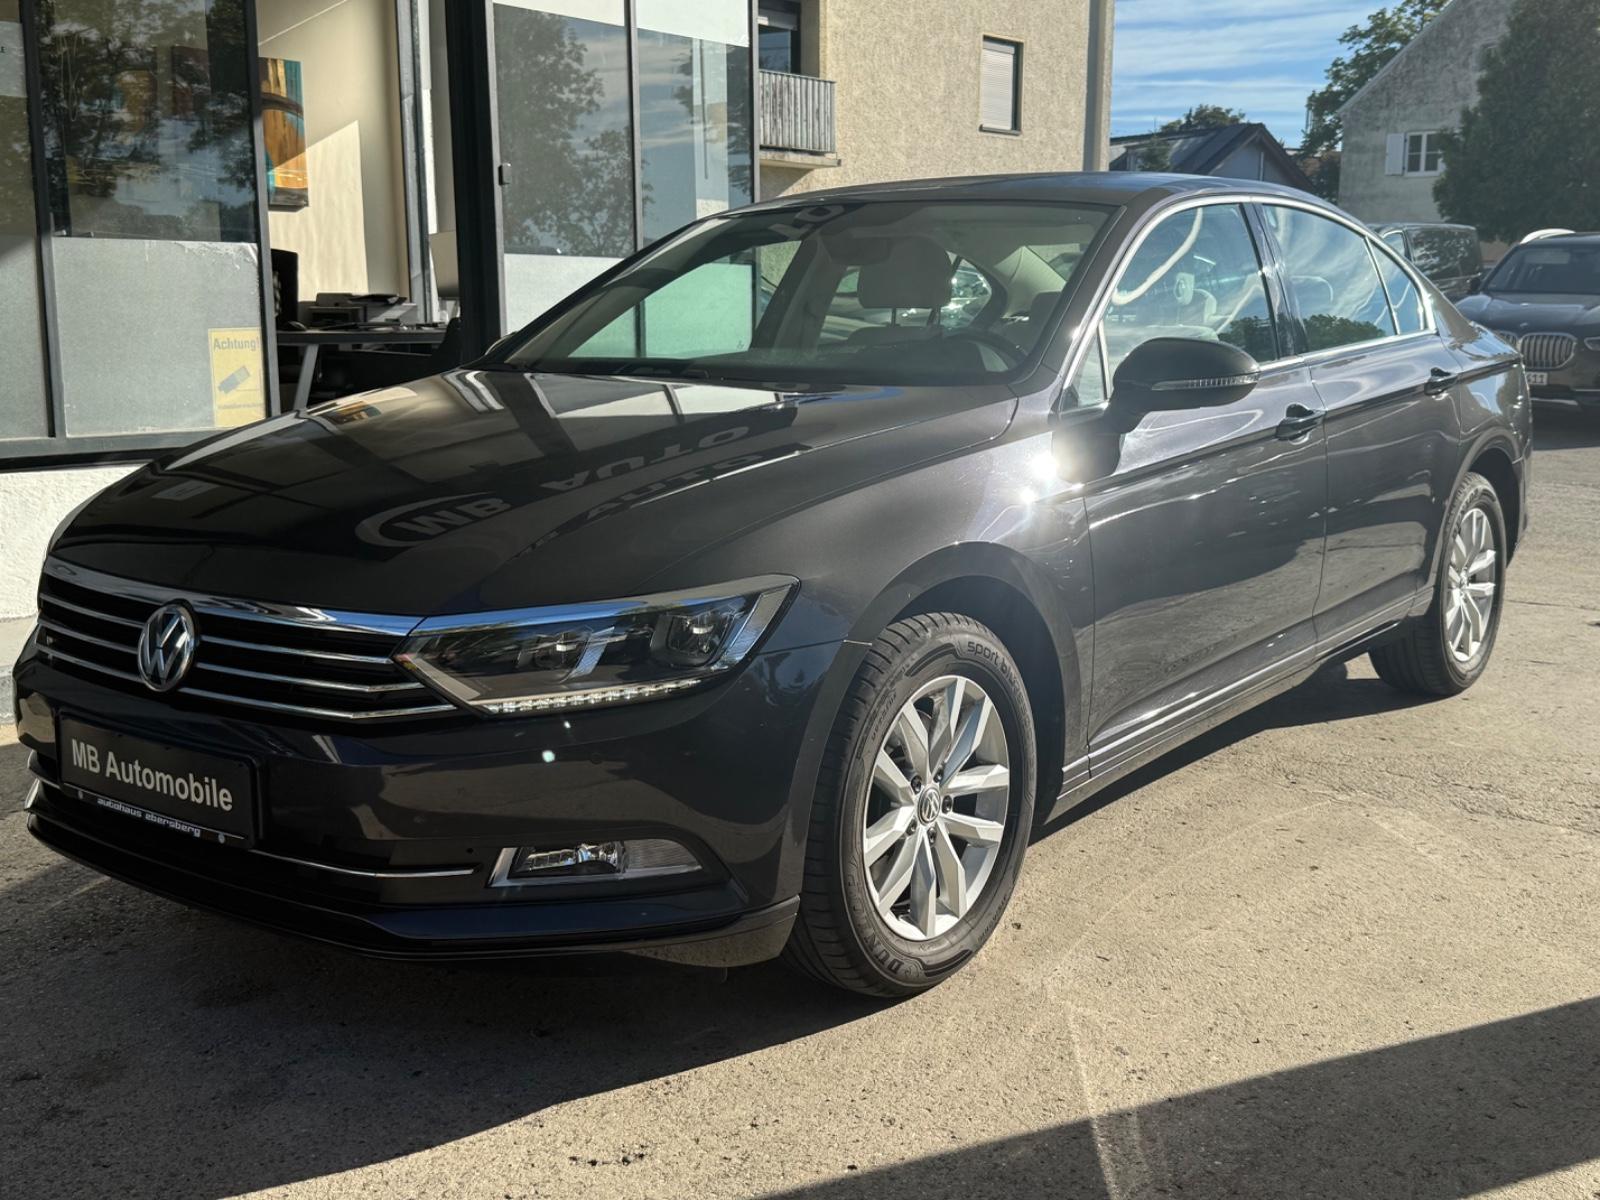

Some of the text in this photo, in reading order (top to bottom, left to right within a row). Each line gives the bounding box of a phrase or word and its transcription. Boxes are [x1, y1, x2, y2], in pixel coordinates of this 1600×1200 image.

[213, 336, 260, 351] Achtung!
[966, 640, 999, 666] sport
[71, 738, 234, 812] MB Automobile
[96, 798, 201, 837] autohaus ebersberg
